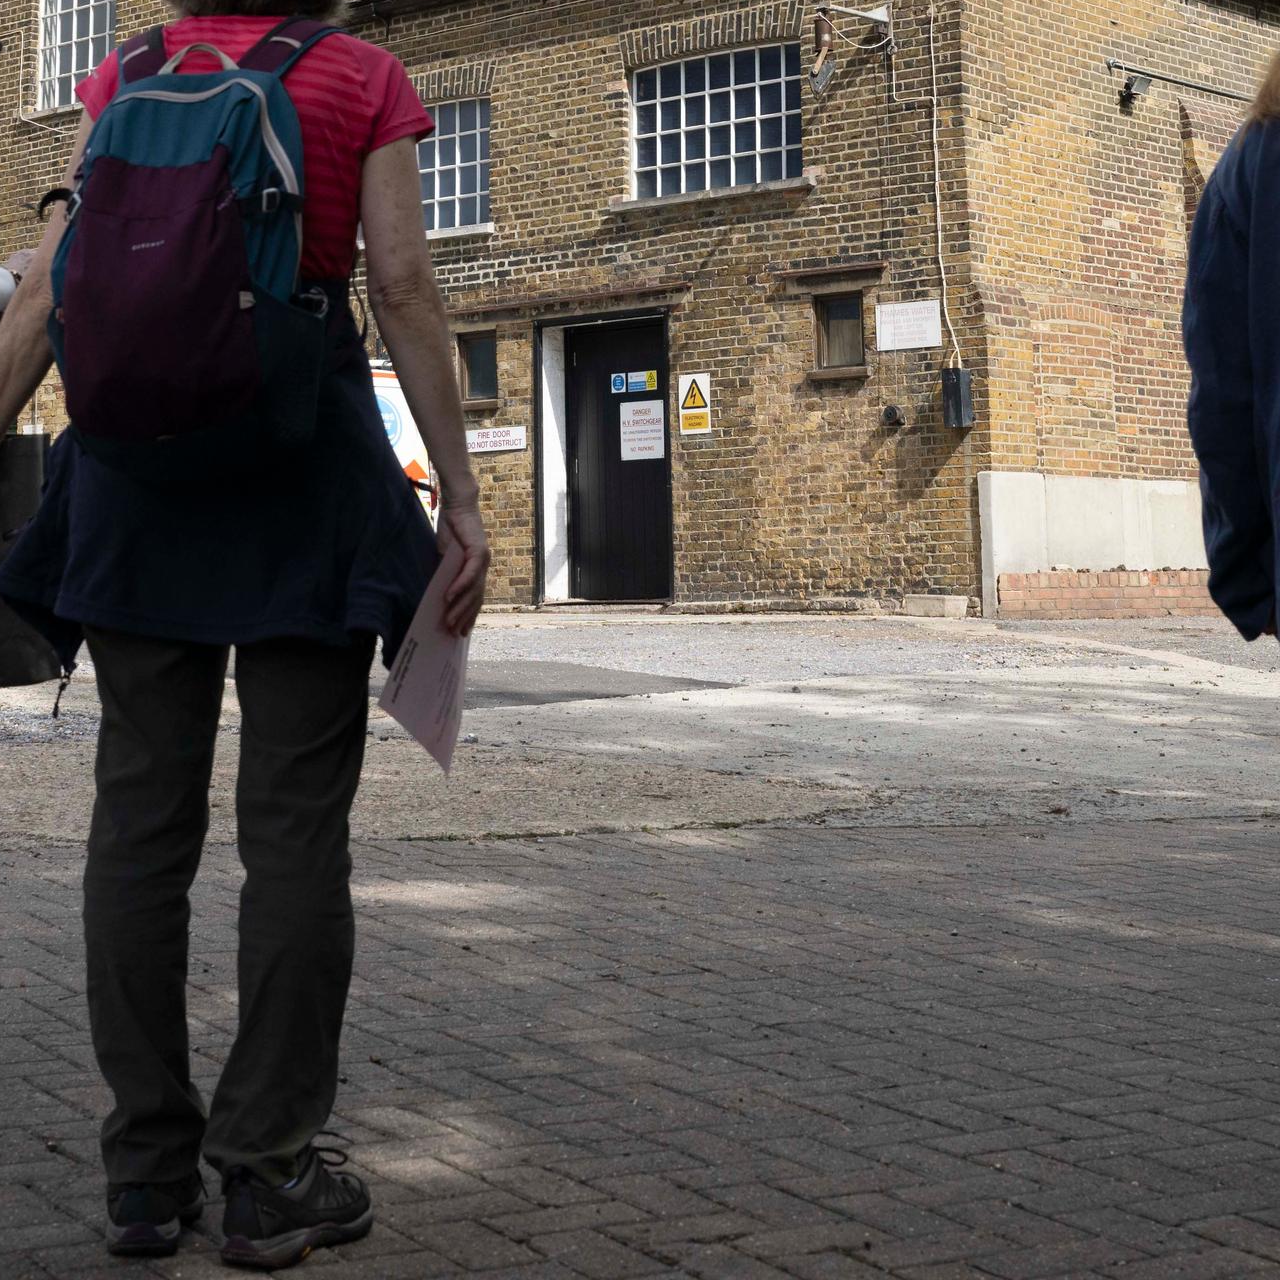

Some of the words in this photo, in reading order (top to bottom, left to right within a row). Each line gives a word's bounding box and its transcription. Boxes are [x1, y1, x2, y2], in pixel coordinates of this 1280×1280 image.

[632, 408, 651, 416] DANGER
[477, 431, 490, 439] FIRE
[492, 430, 511, 438] DOOR
[477, 441, 488, 449] NOT
[489, 439, 522, 448] OBSTRUCT
